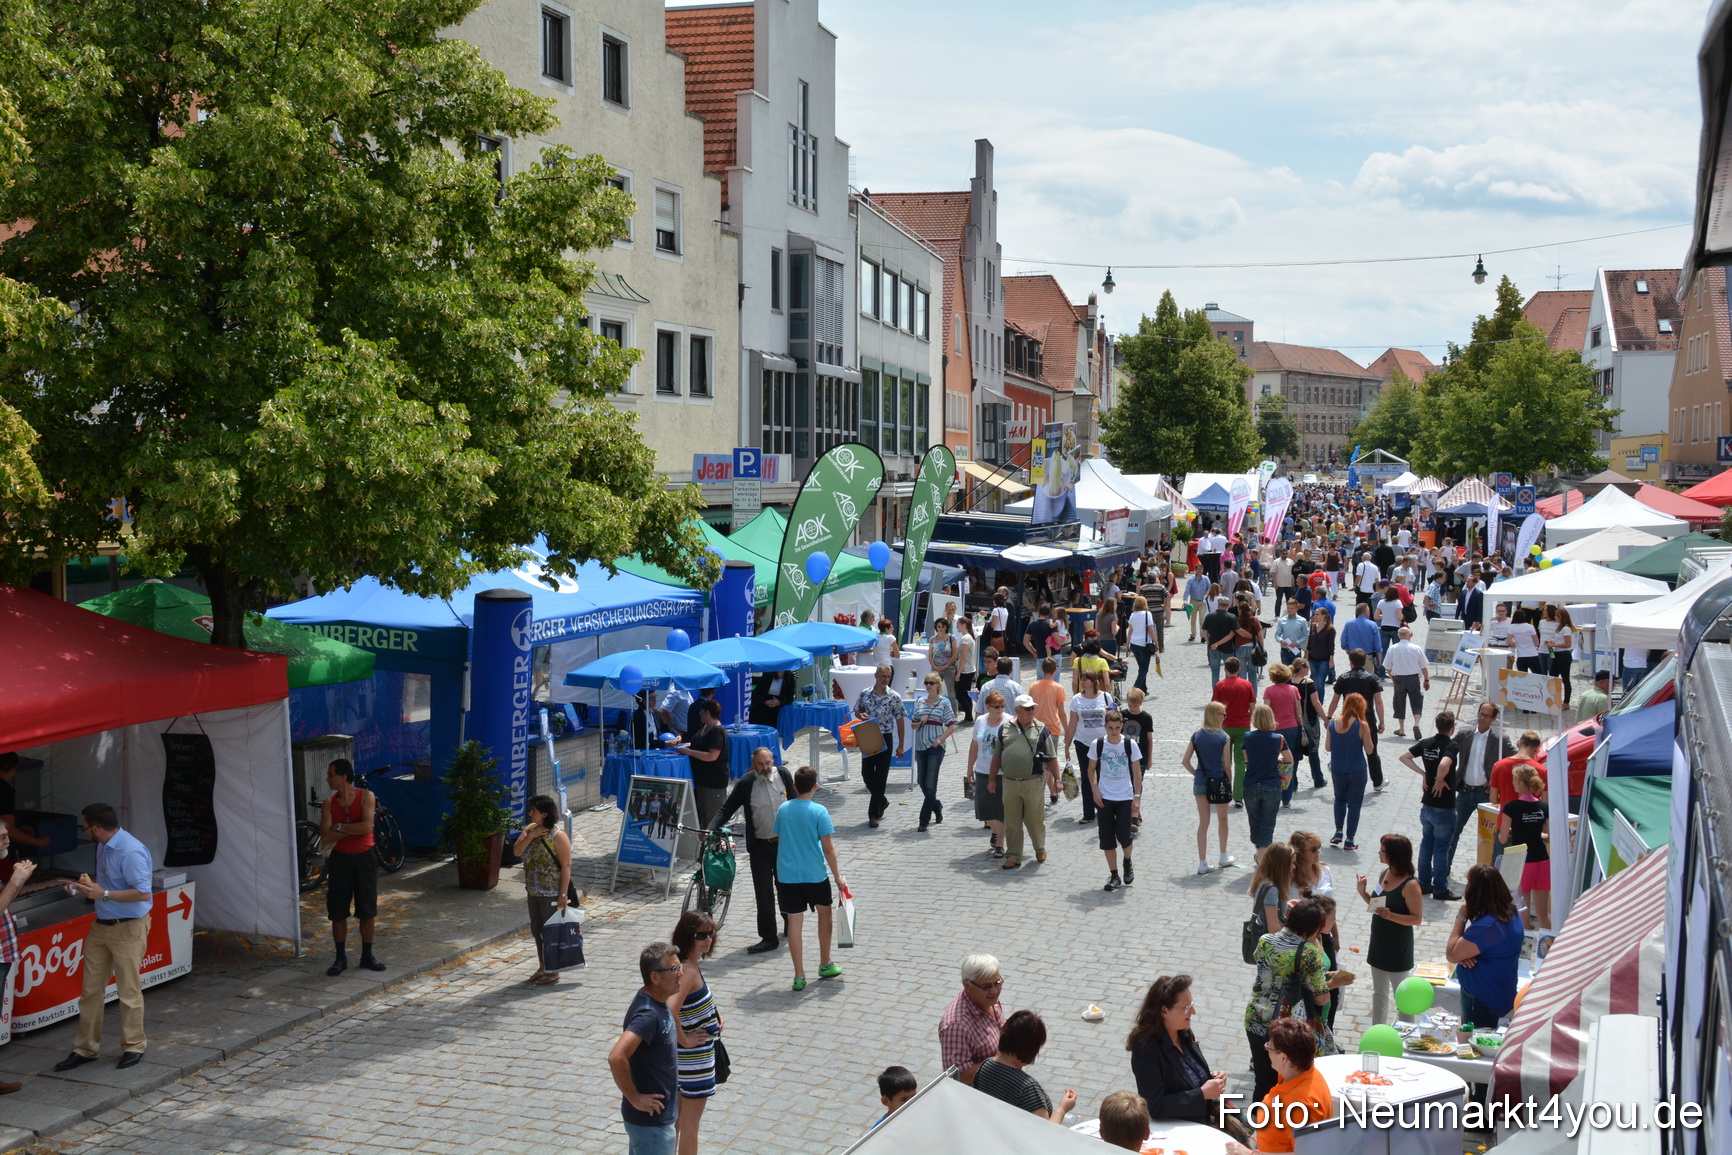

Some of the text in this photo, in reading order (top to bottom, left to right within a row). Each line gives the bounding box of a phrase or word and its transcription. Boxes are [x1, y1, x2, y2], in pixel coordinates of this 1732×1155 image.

[1008, 426, 1027, 438] H&M
[697, 456, 732, 480] Jean
[740, 452, 755, 474] P
[866, 477, 882, 488] AO
[836, 491, 860, 529] AOK
[912, 501, 929, 526] AOK
[795, 513, 831, 547] AOK
[783, 562, 811, 598] AOK
[532, 599, 696, 641] ERGER VERSICHERUNGSGRUPPE
[774, 607, 799, 629] AOK
[1482, 819, 1495, 829] Wir
[14, 932, 84, 997] Bög
[12, 1018, 36, 1031] Obere
[38, 1008, 67, 1025] Marktstr.
[150, 968, 166, 983] 09181
[168, 965, 186, 979] 905135
